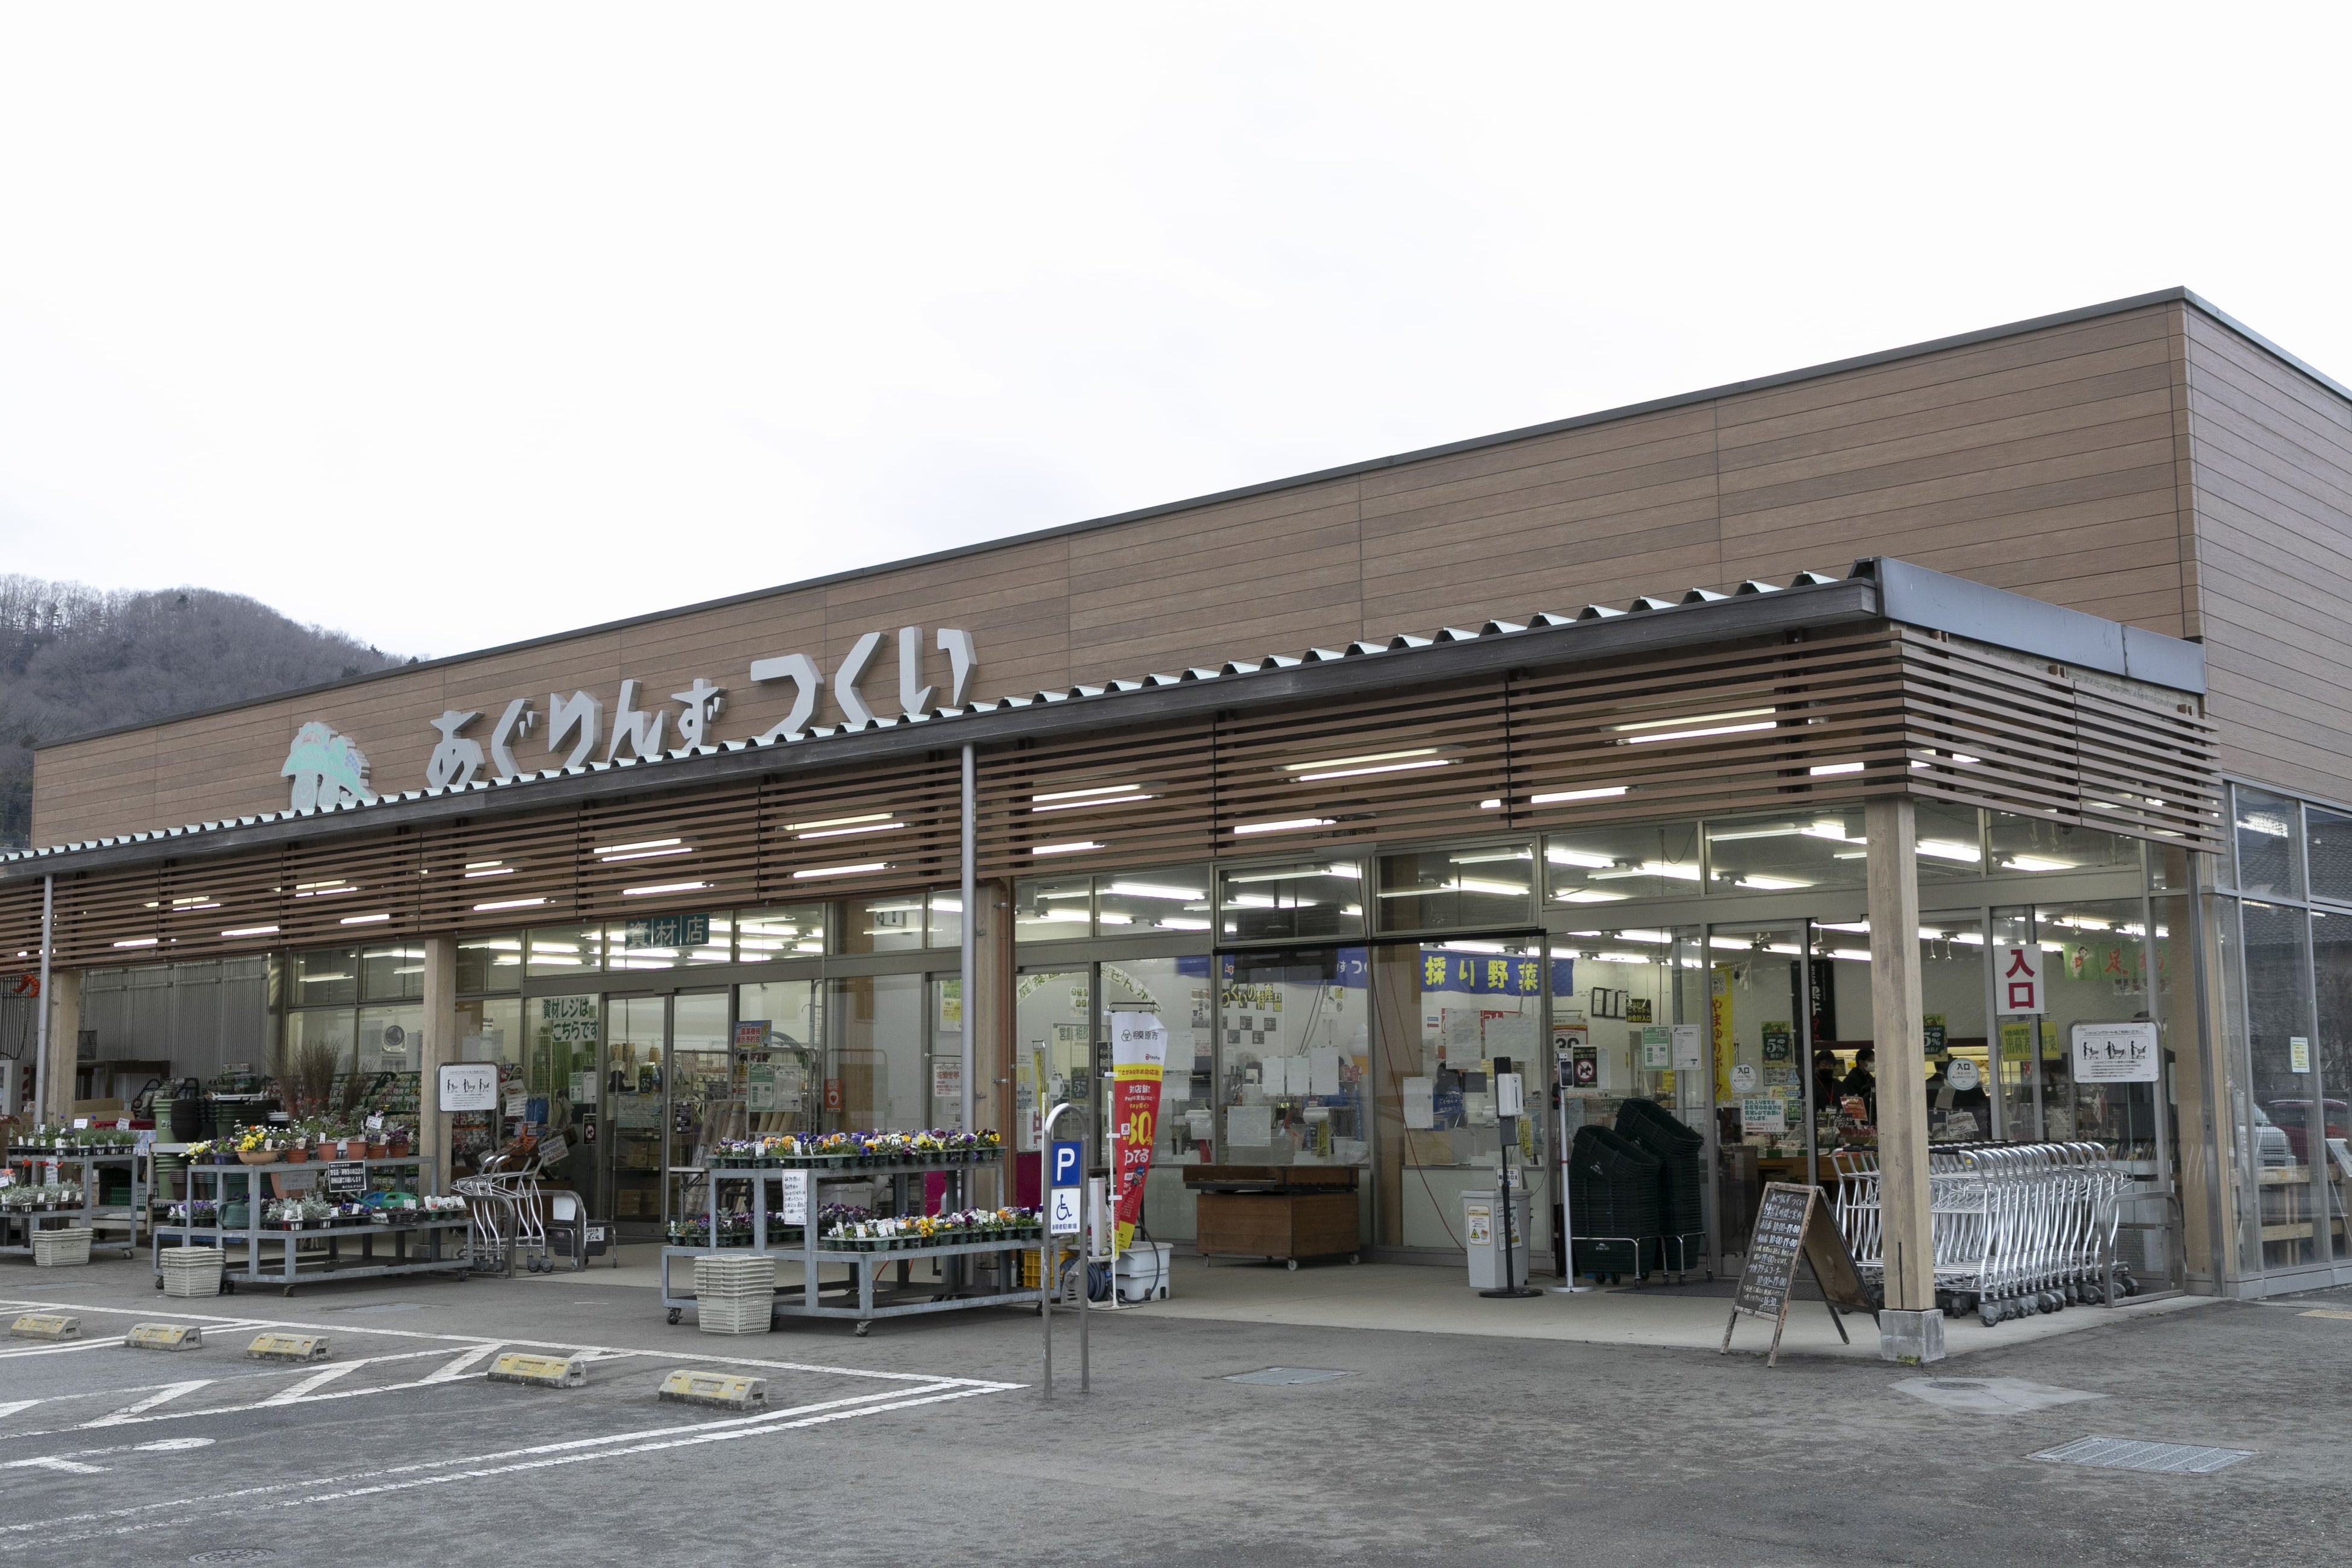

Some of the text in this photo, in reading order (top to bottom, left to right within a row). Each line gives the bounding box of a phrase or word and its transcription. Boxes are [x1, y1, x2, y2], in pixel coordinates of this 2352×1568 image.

[628, 916, 704, 948] 資材店
[1424, 955, 1538, 991] 採り野菜
[2005, 949, 2035, 1009] 入口
[543, 997, 589, 1019] 資材レジは
[1222, 983, 1283, 1012] つくいの特産品
[553, 1020, 598, 1042] こちらです
[1133, 1029, 1159, 1040] 相模原市
[1766, 1038, 1785, 1052] 5%
[1073, 1081, 1086, 1093] 5%
[1057, 1148, 1075, 1181] P
